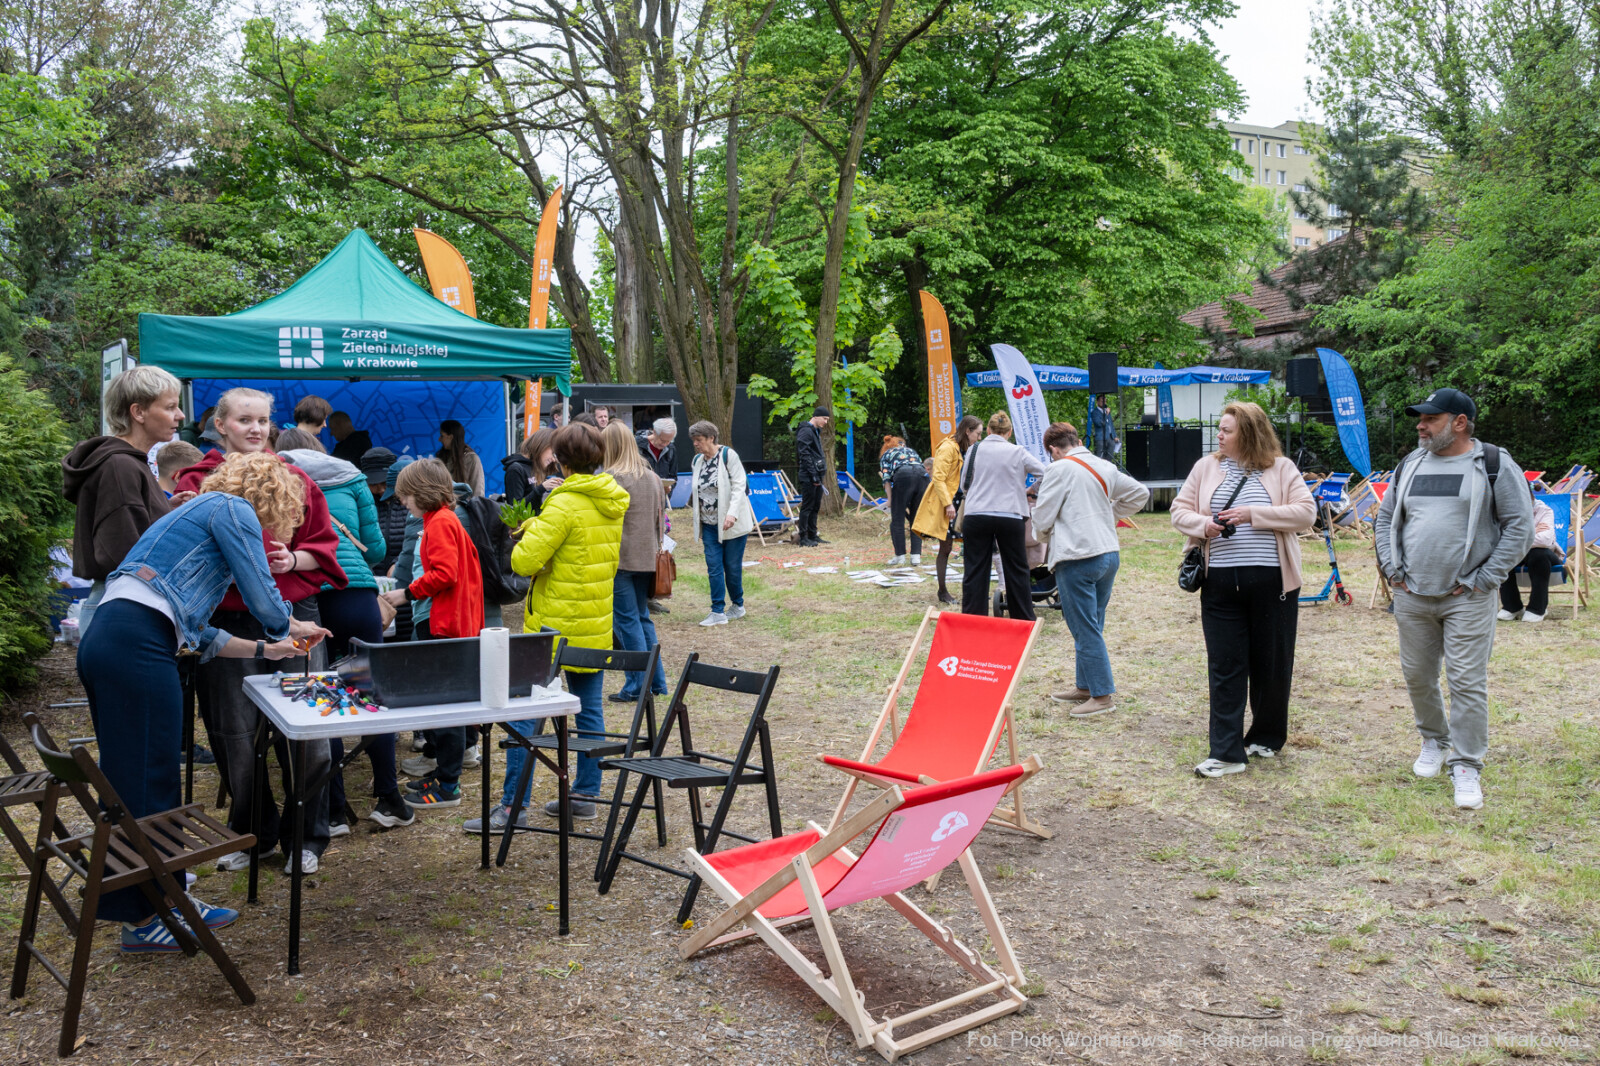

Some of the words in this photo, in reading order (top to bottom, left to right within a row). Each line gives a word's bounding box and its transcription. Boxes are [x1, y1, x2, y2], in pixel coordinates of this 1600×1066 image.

[341, 327, 387, 342] Zarząd
[342, 342, 387, 354] Zieleni
[390, 343, 448, 358] Miejskiej
[342, 359, 354, 367] w
[357, 357, 418, 368] Krakowie
[1051, 373, 1082, 384] Kraków
[1141, 375, 1171, 384] Kraków
[1222, 372, 1251, 382] Kraków
